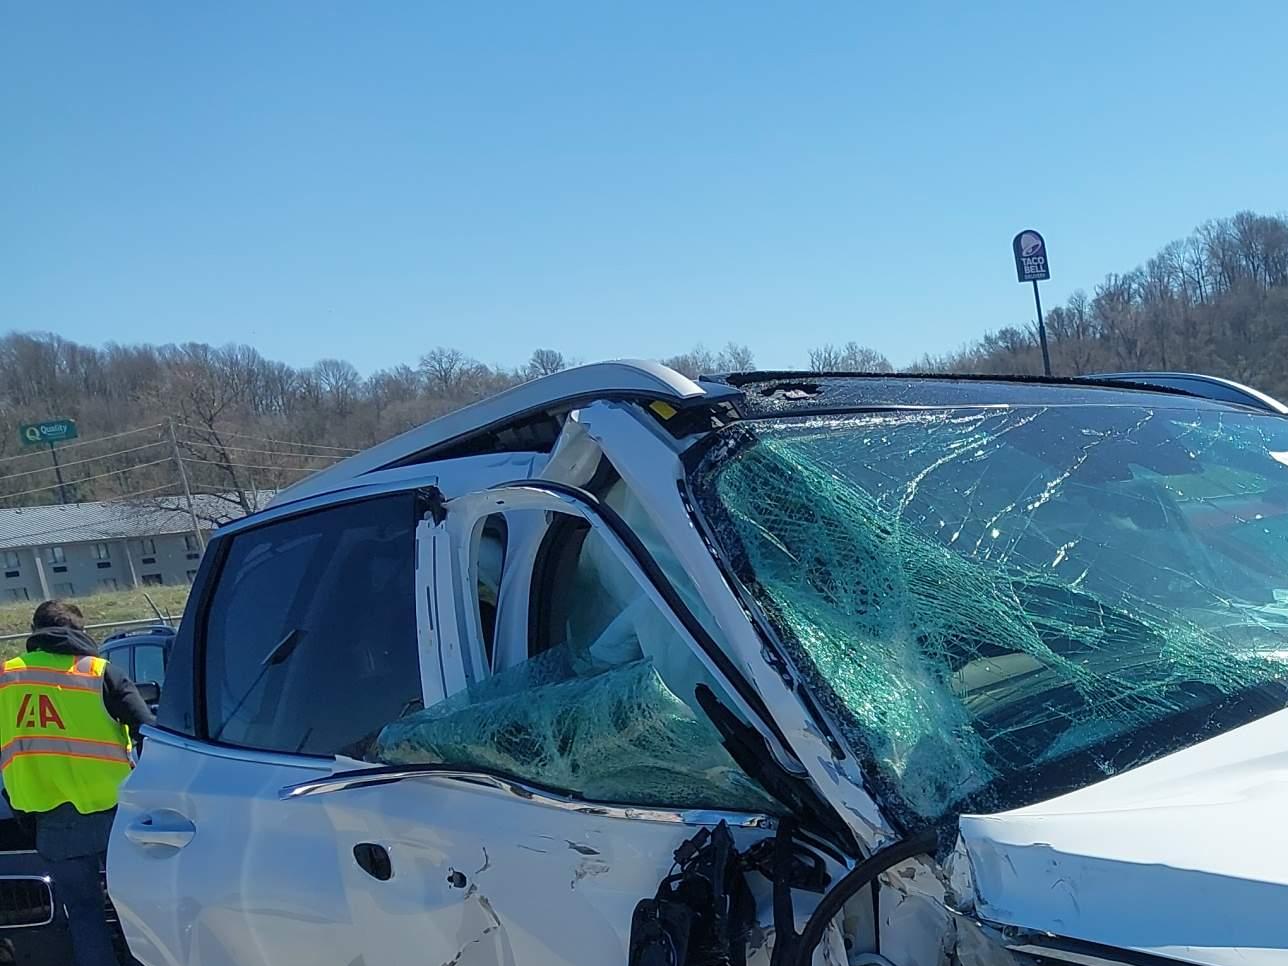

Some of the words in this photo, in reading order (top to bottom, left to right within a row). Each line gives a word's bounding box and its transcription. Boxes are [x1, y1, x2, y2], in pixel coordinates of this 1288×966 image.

[1021, 257, 1045, 266] TACO
[1024, 264, 1046, 273] BELL
[40, 424, 67, 434] Quality
